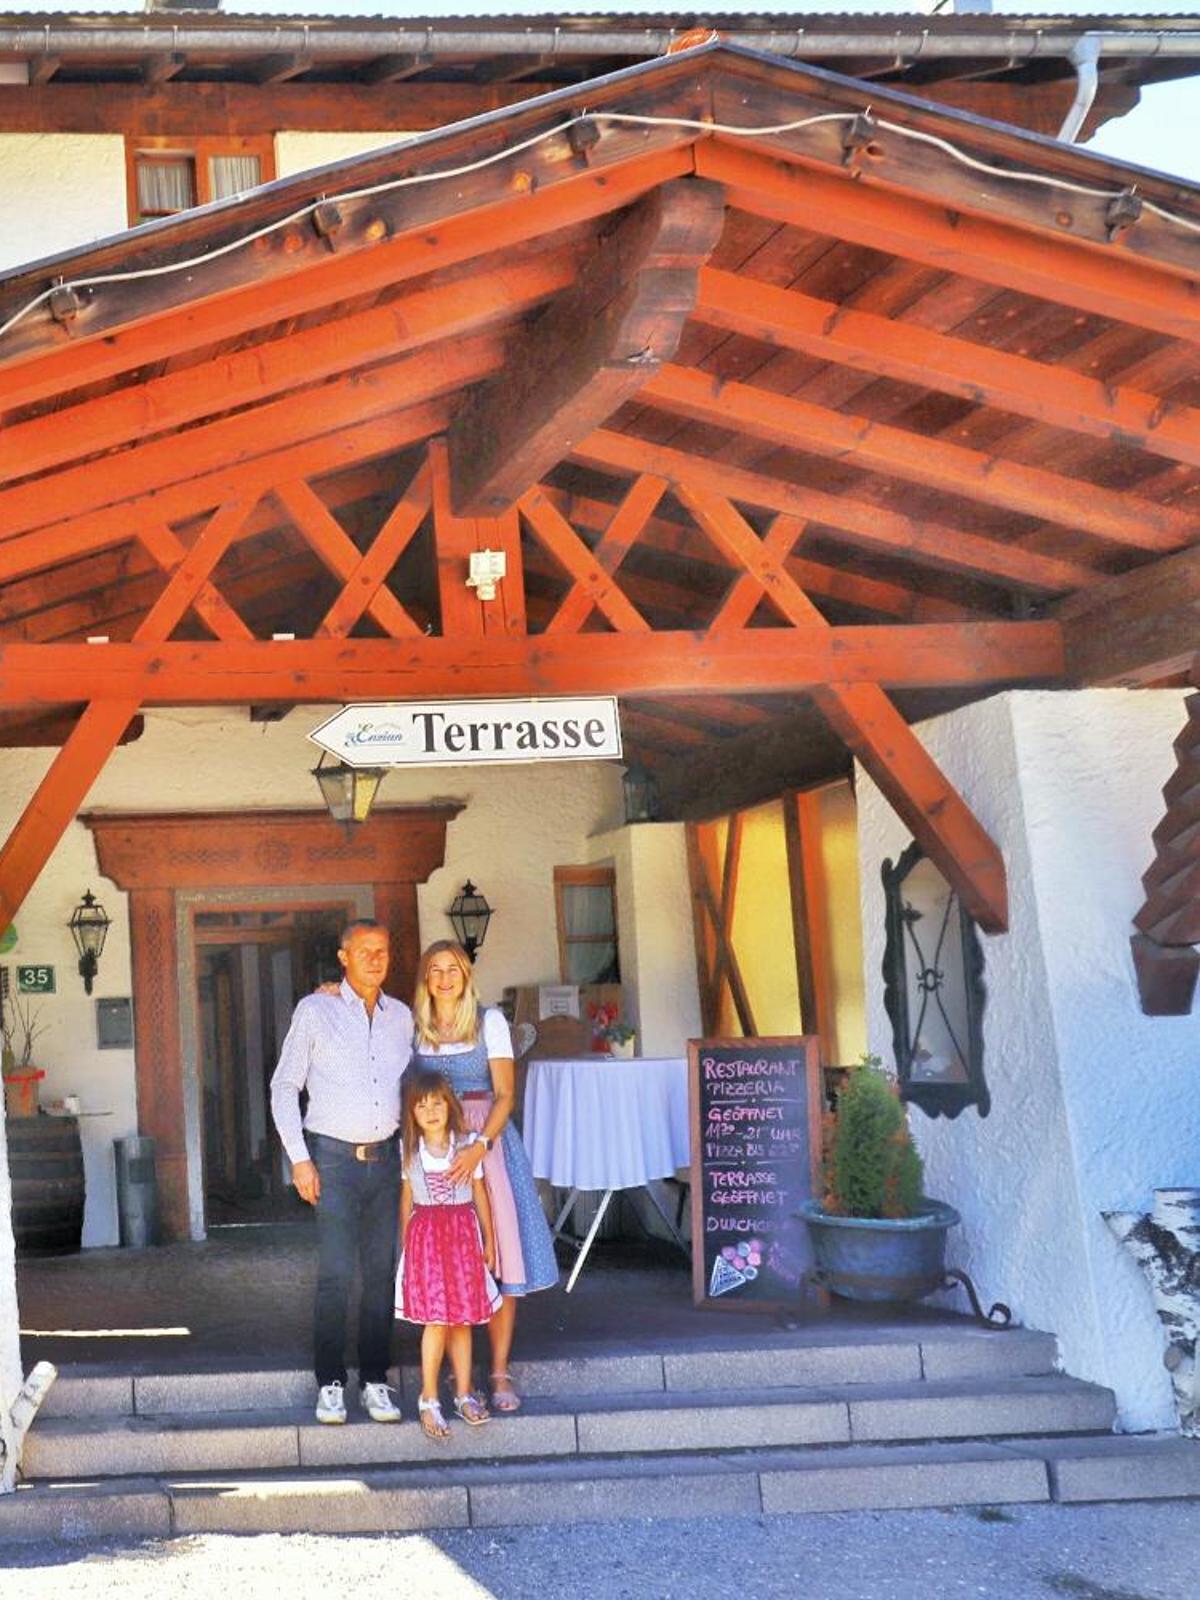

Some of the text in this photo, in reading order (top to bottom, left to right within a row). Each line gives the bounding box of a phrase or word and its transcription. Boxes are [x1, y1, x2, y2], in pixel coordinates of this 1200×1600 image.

[412, 711, 606, 753] Terrasse
[25, 969, 48, 984] 35
[703, 1057, 799, 1079] RESTAURANT
[706, 1080, 785, 1096] PIZZERIA
[708, 1170, 777, 1188] TERRASSE
